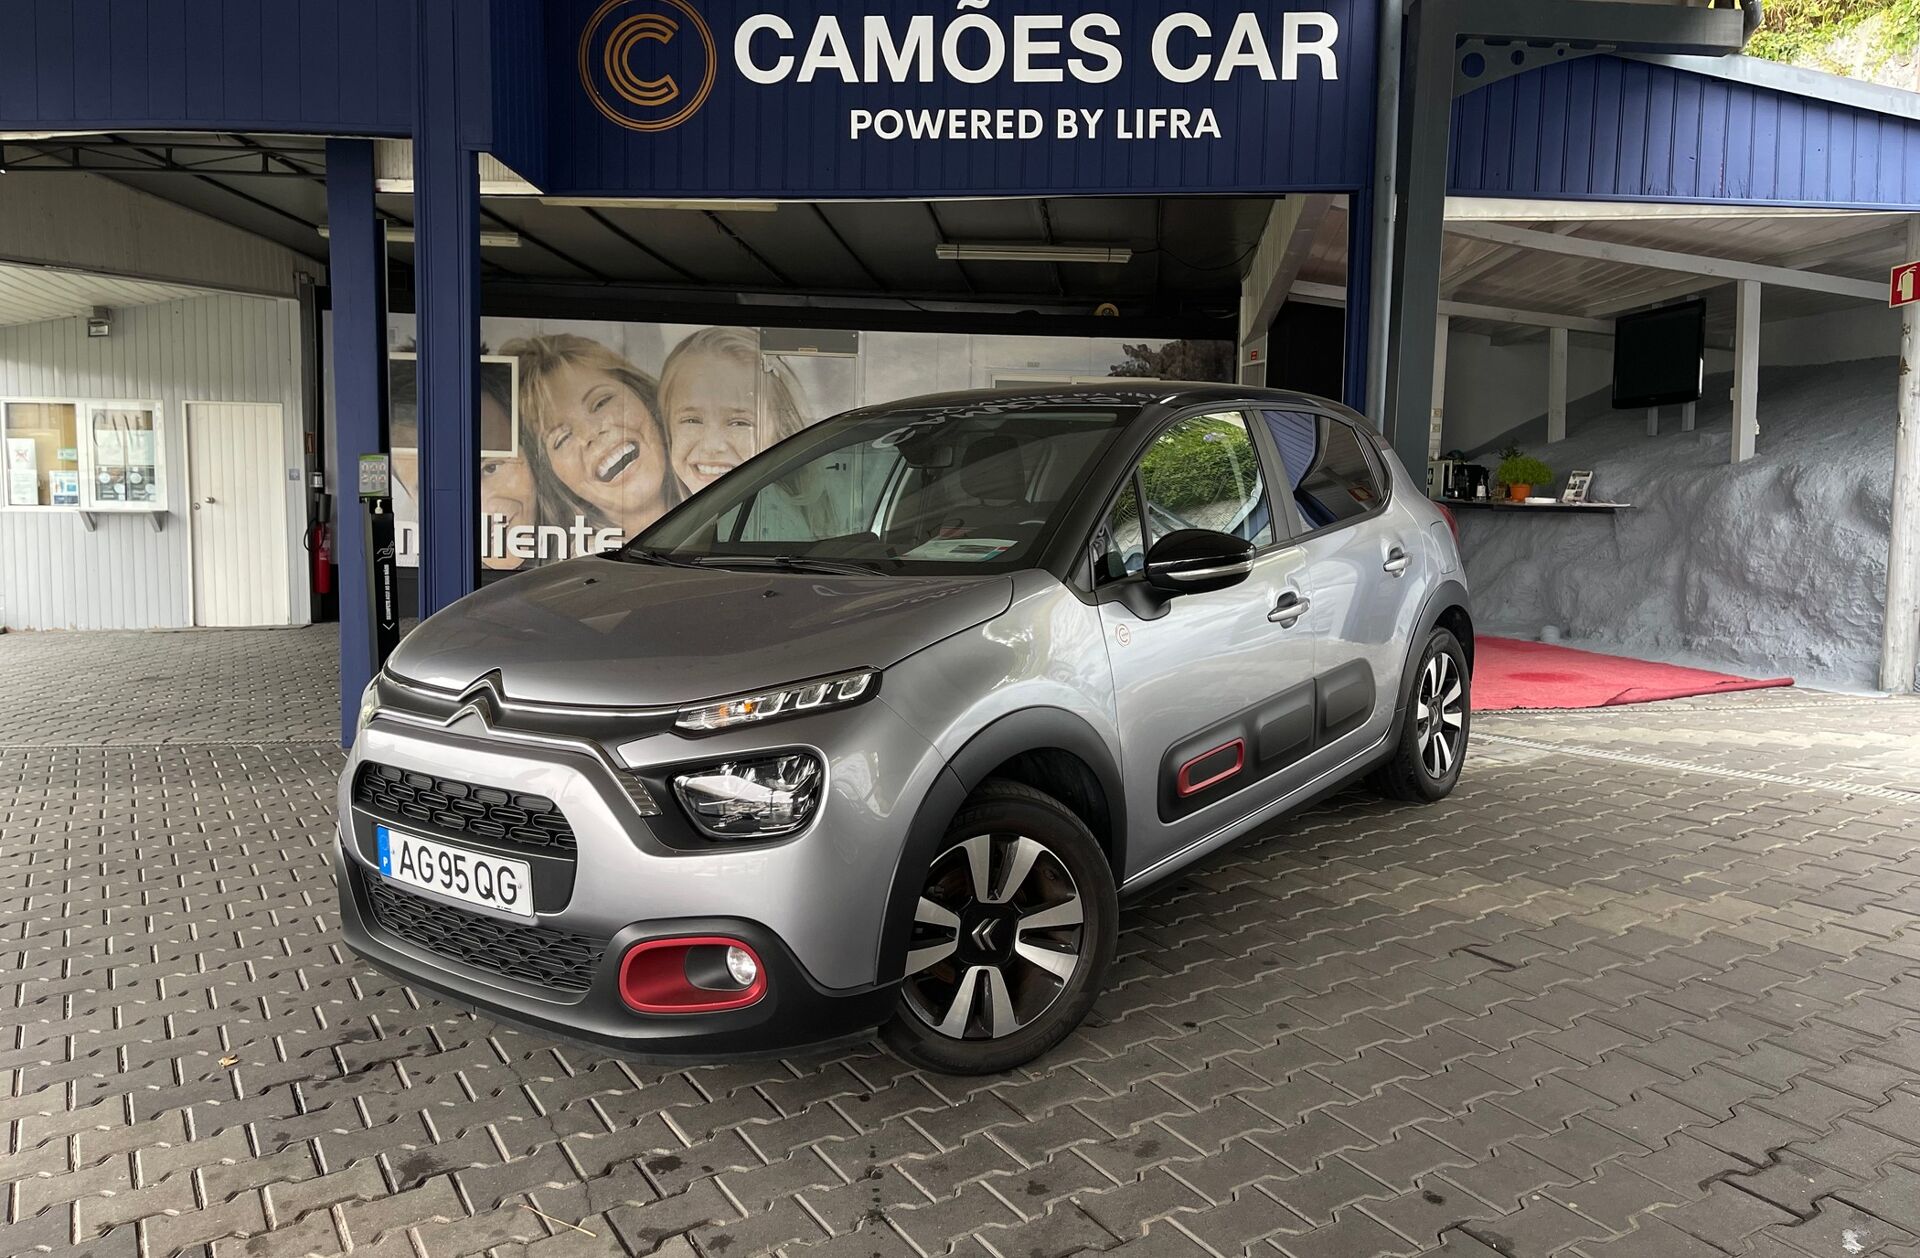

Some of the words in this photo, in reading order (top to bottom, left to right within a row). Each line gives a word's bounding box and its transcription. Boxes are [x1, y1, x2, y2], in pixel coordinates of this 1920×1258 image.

[734, 0, 1123, 84] CAMÕES
[1151, 12, 1339, 83] CAR
[850, 109, 1044, 140] POWERED
[1057, 108, 1104, 139] BY
[1117, 108, 1221, 139] LIFRA
